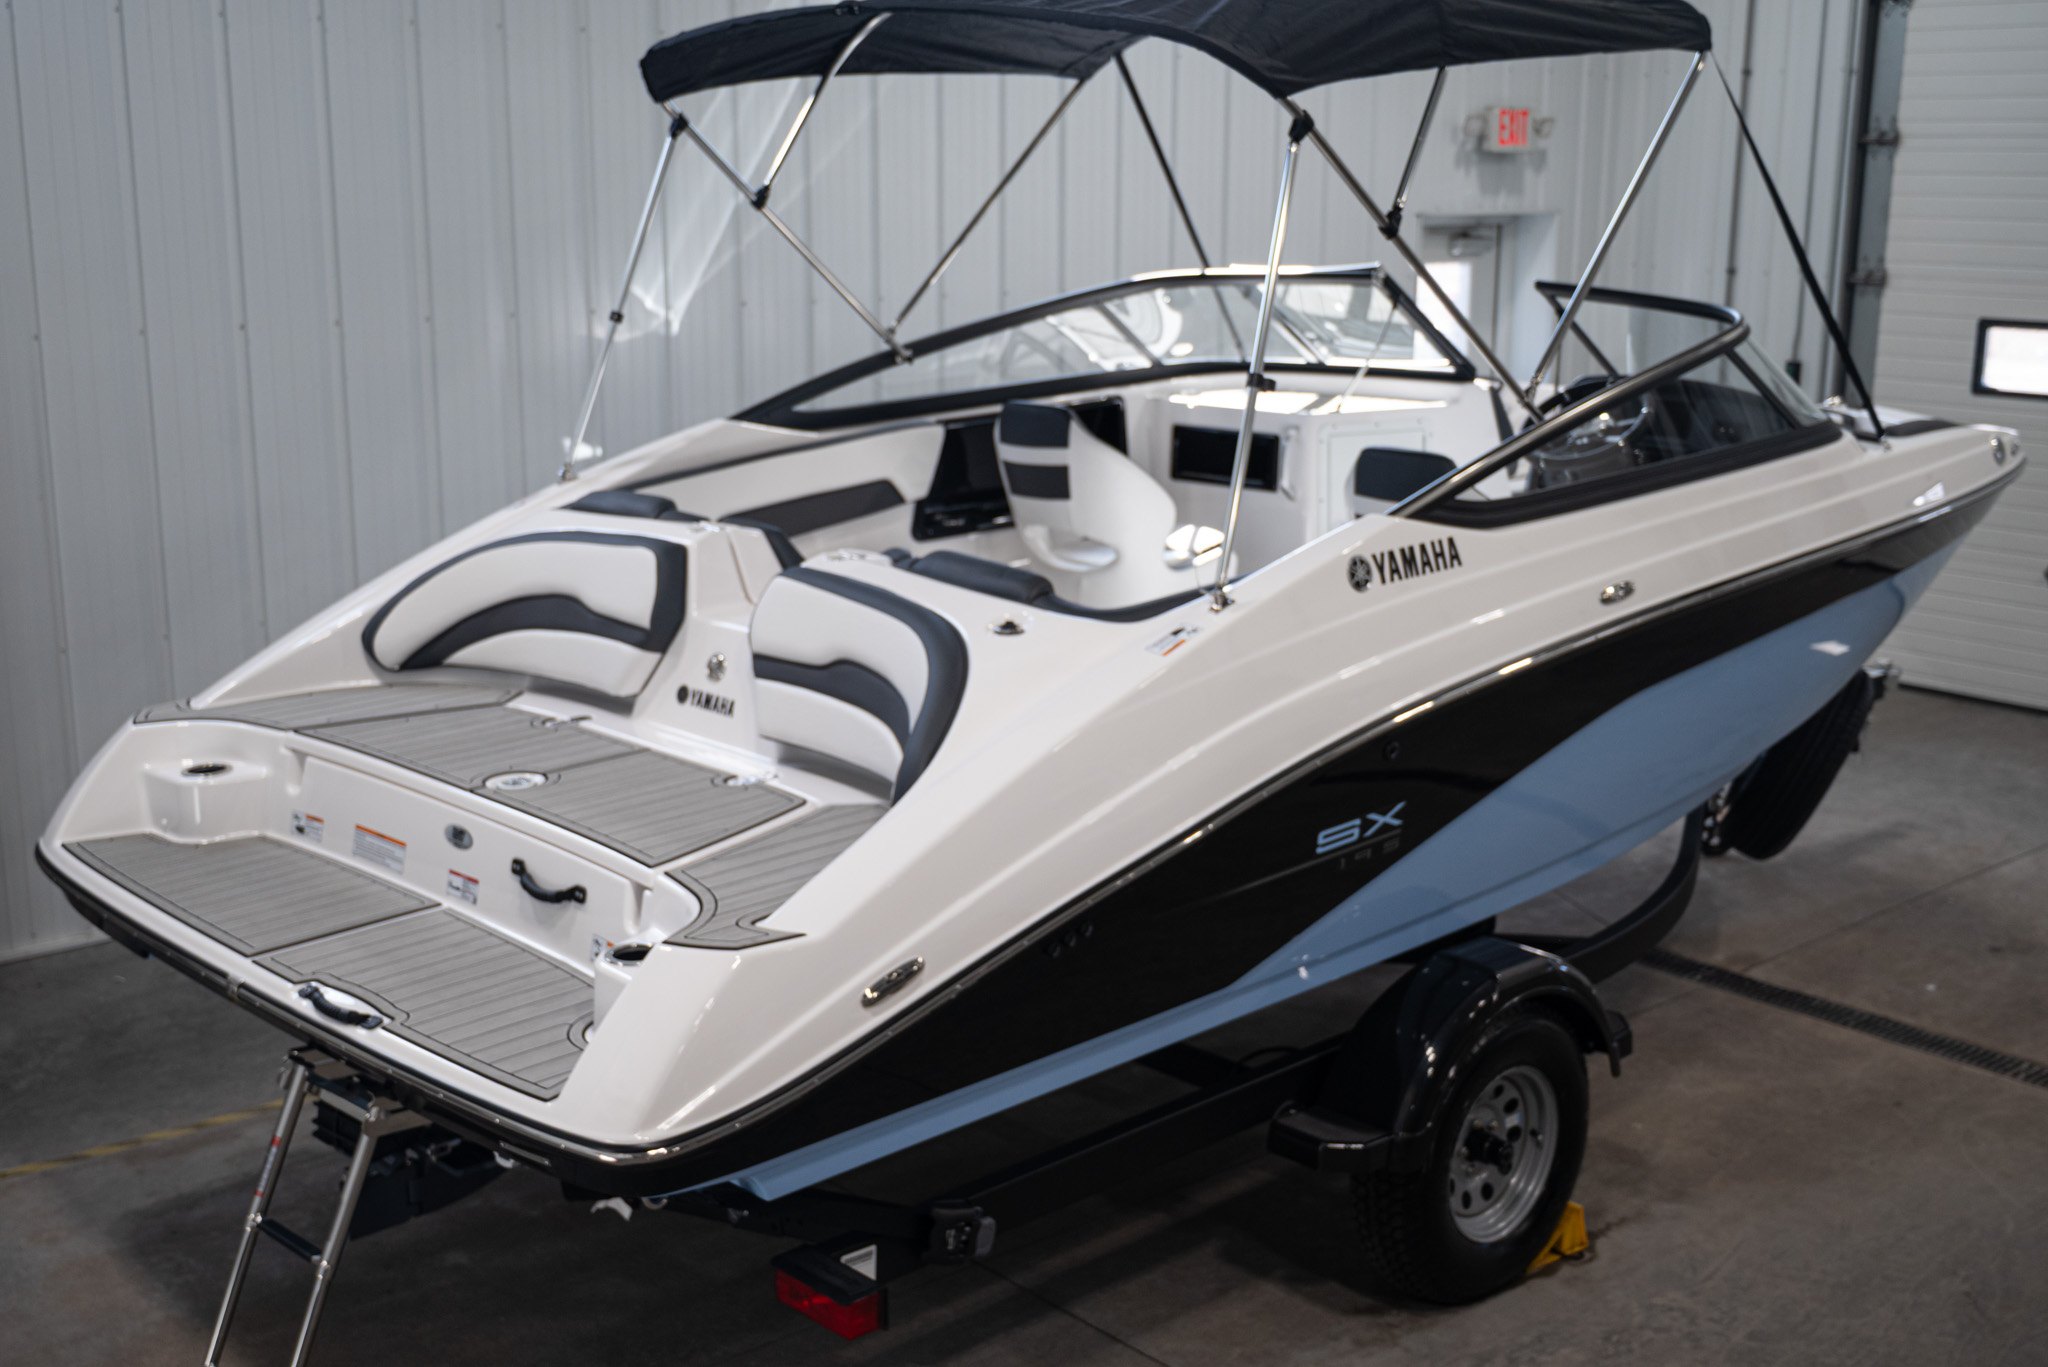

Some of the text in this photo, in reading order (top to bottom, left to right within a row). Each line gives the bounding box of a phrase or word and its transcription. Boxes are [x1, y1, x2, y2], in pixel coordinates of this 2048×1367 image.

[1371, 535, 1462, 585] YAMAHA
[690, 688, 735, 718] YAMAHA
[1315, 800, 1407, 855] SX
